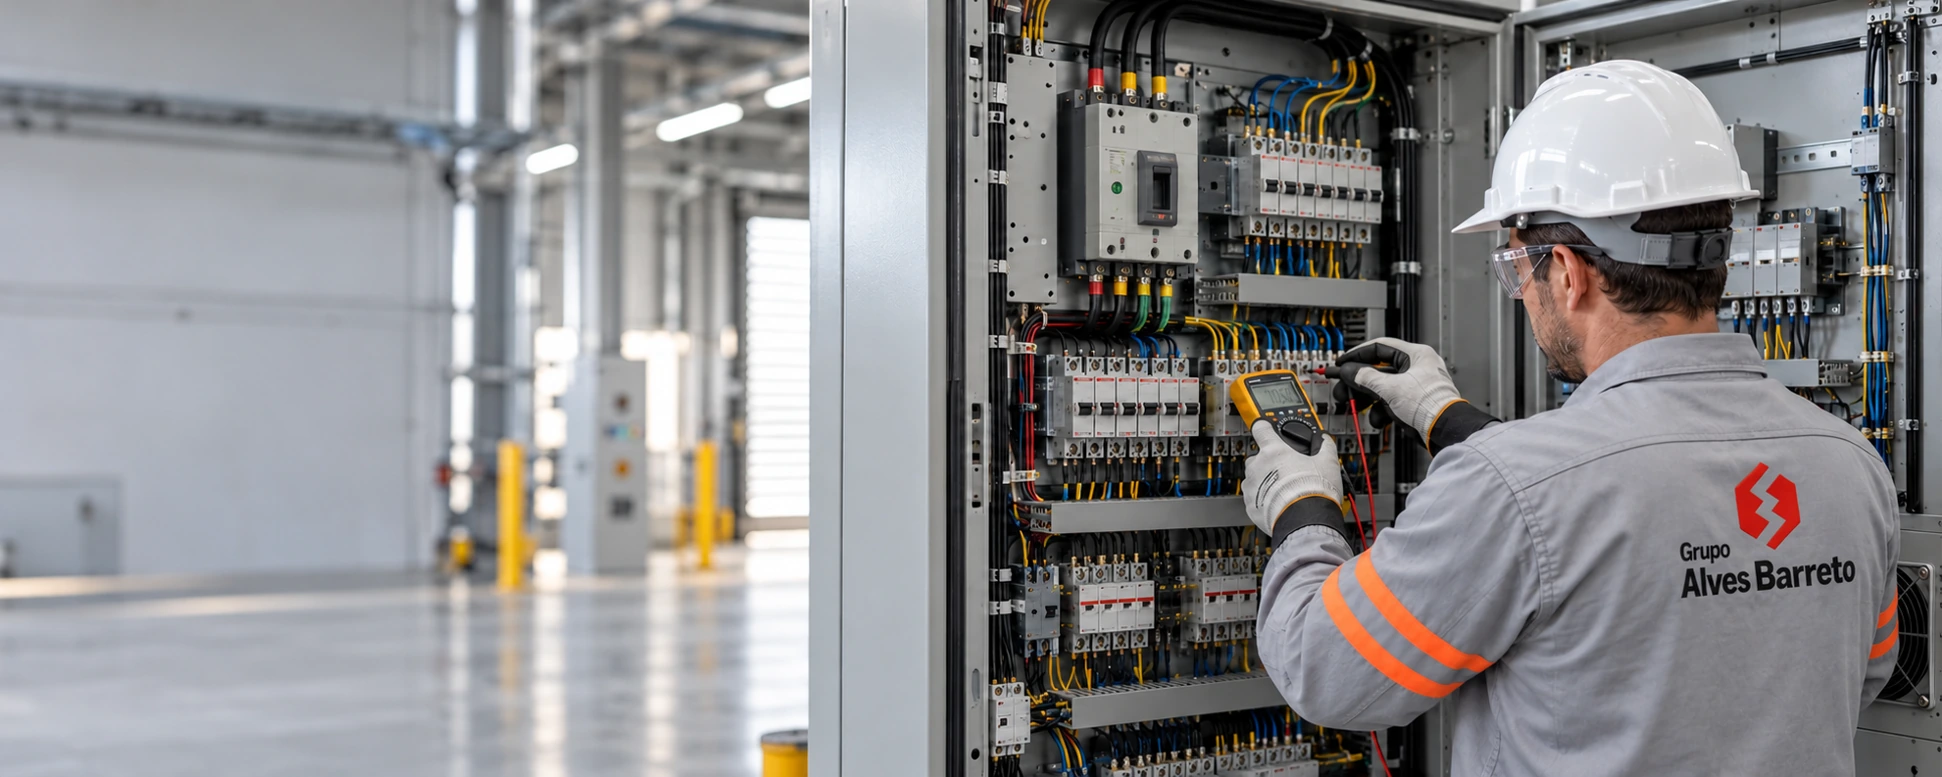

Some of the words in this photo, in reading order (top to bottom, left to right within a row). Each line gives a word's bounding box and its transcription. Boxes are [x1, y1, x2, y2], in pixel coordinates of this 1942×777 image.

[1680, 542, 1730, 564] Grupo
[1681, 567, 1751, 598] Alves
[1754, 556, 1856, 591] Barreto
